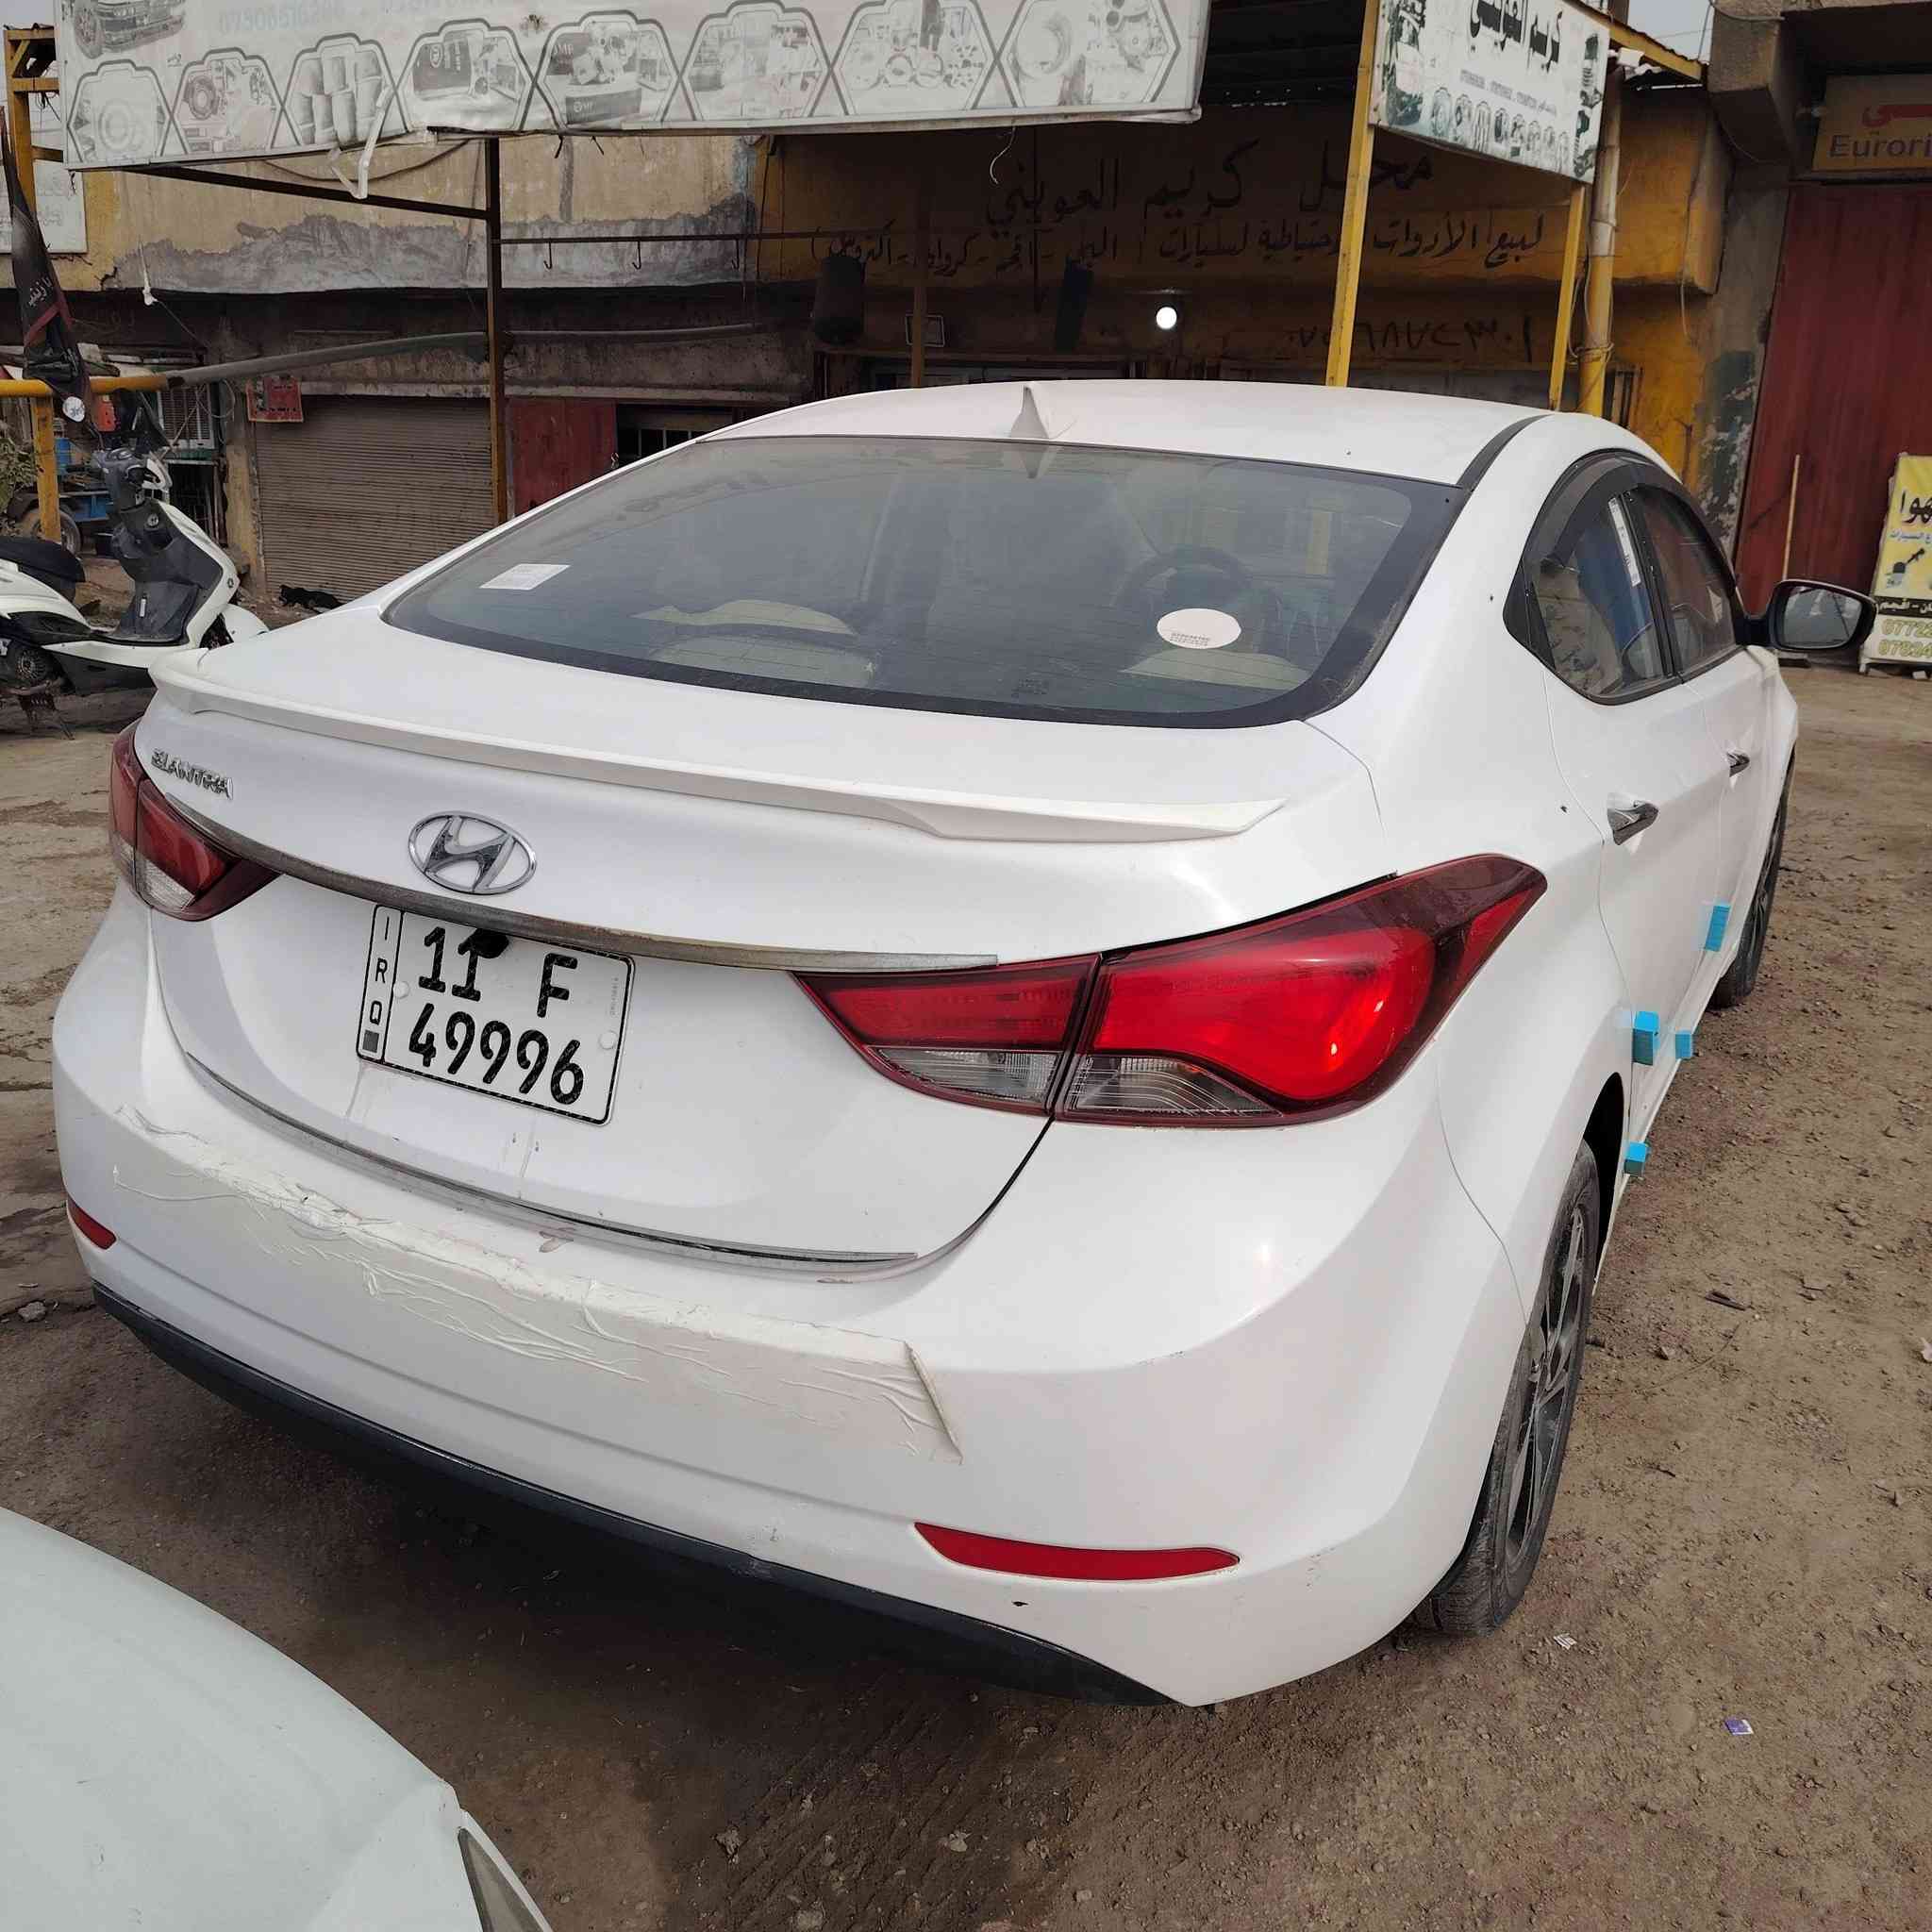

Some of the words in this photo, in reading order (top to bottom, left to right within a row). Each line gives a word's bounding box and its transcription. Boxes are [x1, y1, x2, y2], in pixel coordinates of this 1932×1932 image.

[1484, 213, 1543, 268] لبيع
[151, 751, 233, 800] ELANTRA
[418, 926, 483, 1002] 11
[536, 952, 578, 1018] F
[408, 1002, 585, 1106] 49996
